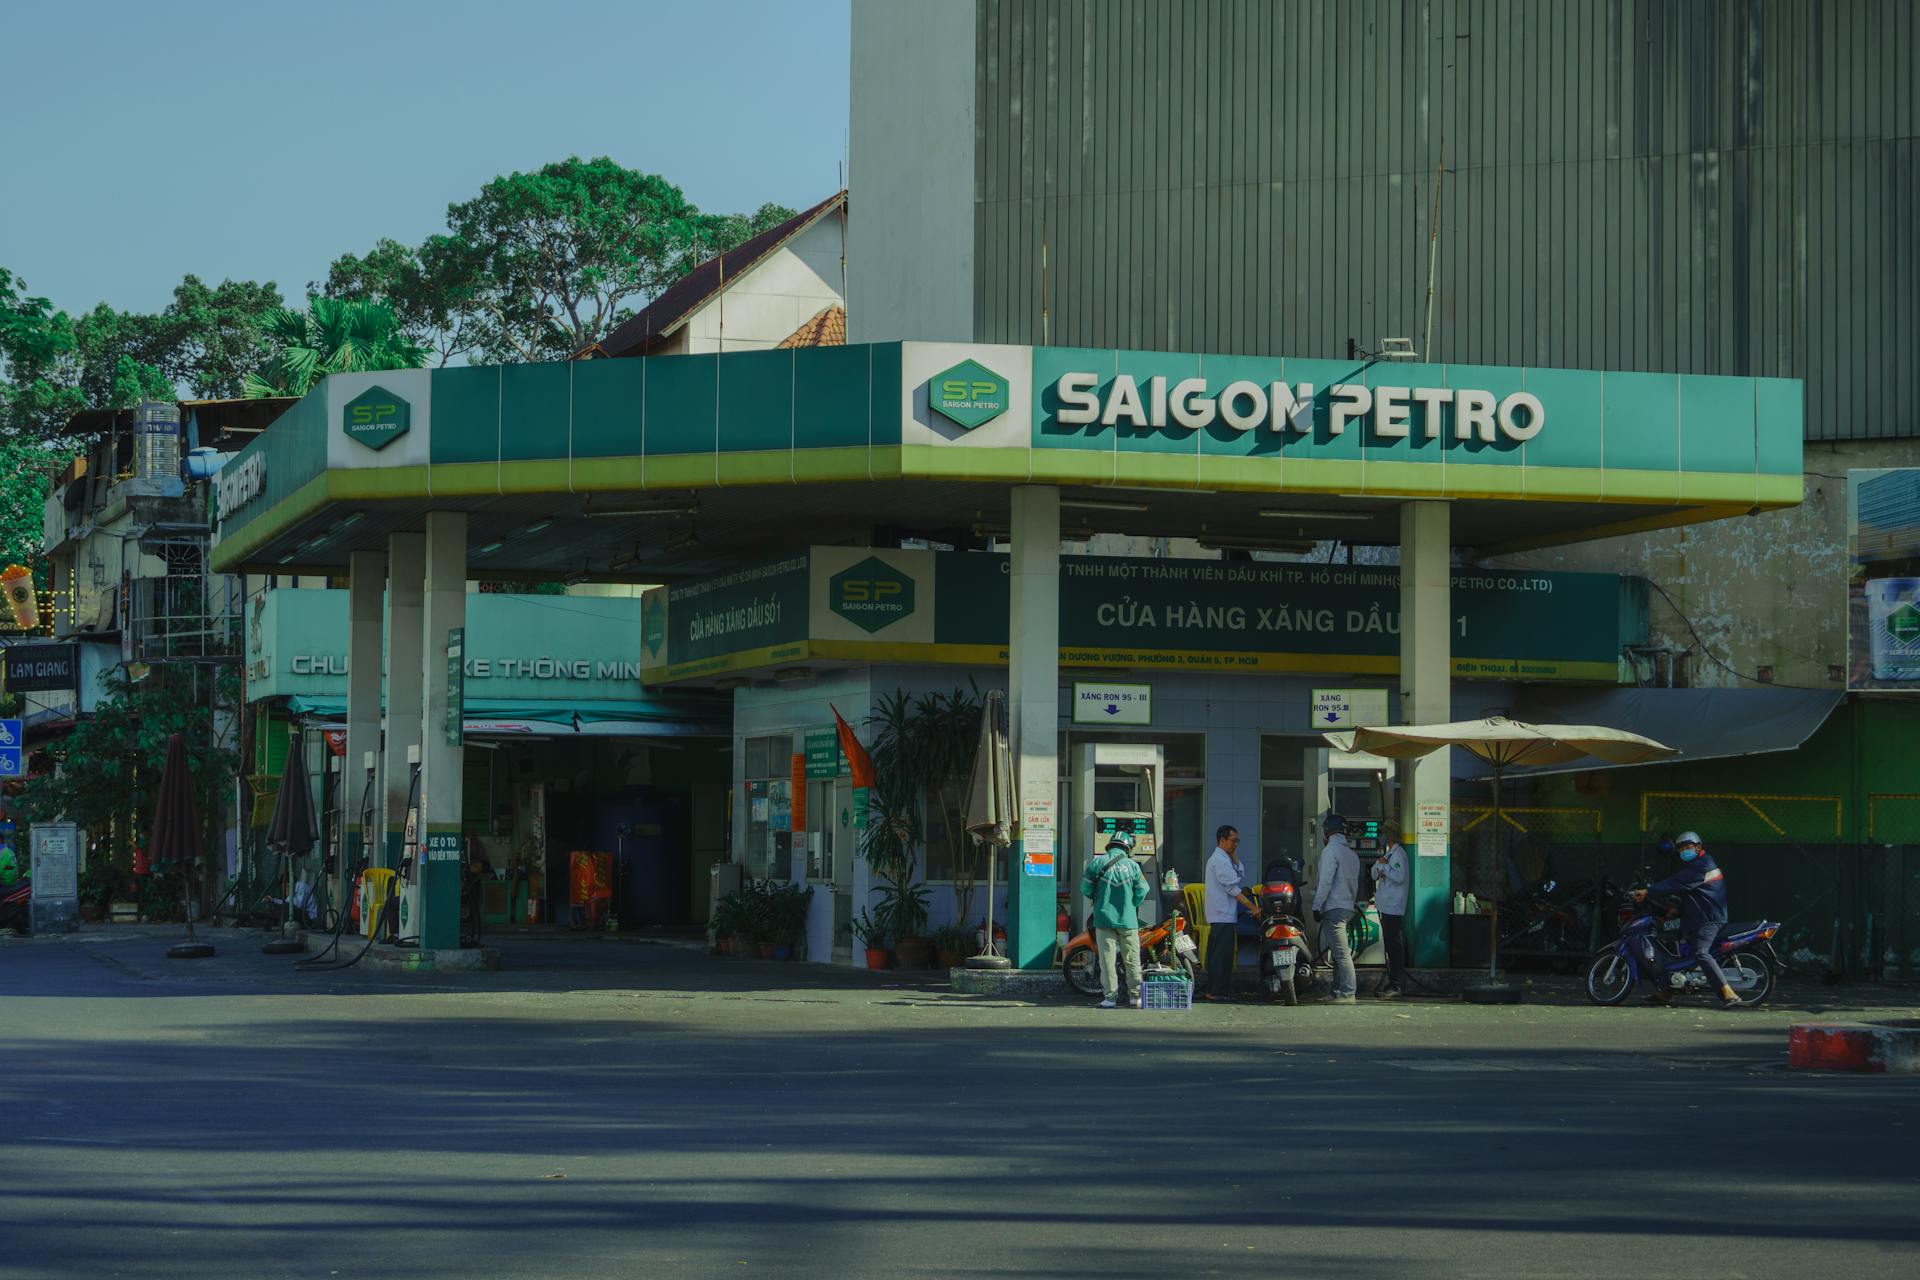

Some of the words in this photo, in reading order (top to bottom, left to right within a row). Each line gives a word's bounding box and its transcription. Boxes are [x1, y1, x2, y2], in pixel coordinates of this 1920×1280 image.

[943, 380, 998, 401] SP
[352, 404, 397, 424] SP
[942, 400, 971, 409] SAIGON
[1057, 372, 1314, 433] SAIGON
[1329, 384, 1545, 442] PETRO
[1068, 564, 1104, 577] TNHH
[1109, 564, 1137, 580] MỘT
[1144, 565, 1188, 580] THÀNH
[1193, 566, 1224, 581] VIÊN
[1260, 567, 1284, 583] KHÍ
[1287, 571, 1305, 583] TP.
[1334, 570, 1357, 585] CHÍ
[1450, 577, 1495, 590] PETRO
[843, 580, 903, 602] SP
[764, 591, 776, 625] SỐ
[776, 600, 782, 623] 1
[842, 602, 874, 611] SAIGON
[875, 603, 903, 611] PETRO
[1096, 595, 1158, 627] CỬA
[1166, 600, 1246, 630] HÀNG
[1256, 602, 1335, 632] XĂNG
[1346, 601, 1401, 634] DẦU
[1456, 615, 1468, 637] 1
[10, 663, 33, 678] LAM
[36, 660, 69, 677] GIANG
[291, 655, 349, 675] CHU
[499, 655, 591, 679] THÔNG
[597, 661, 641, 680] MIN
[1103, 693, 1120, 701] RON
[1313, 703, 1329, 712] RON
